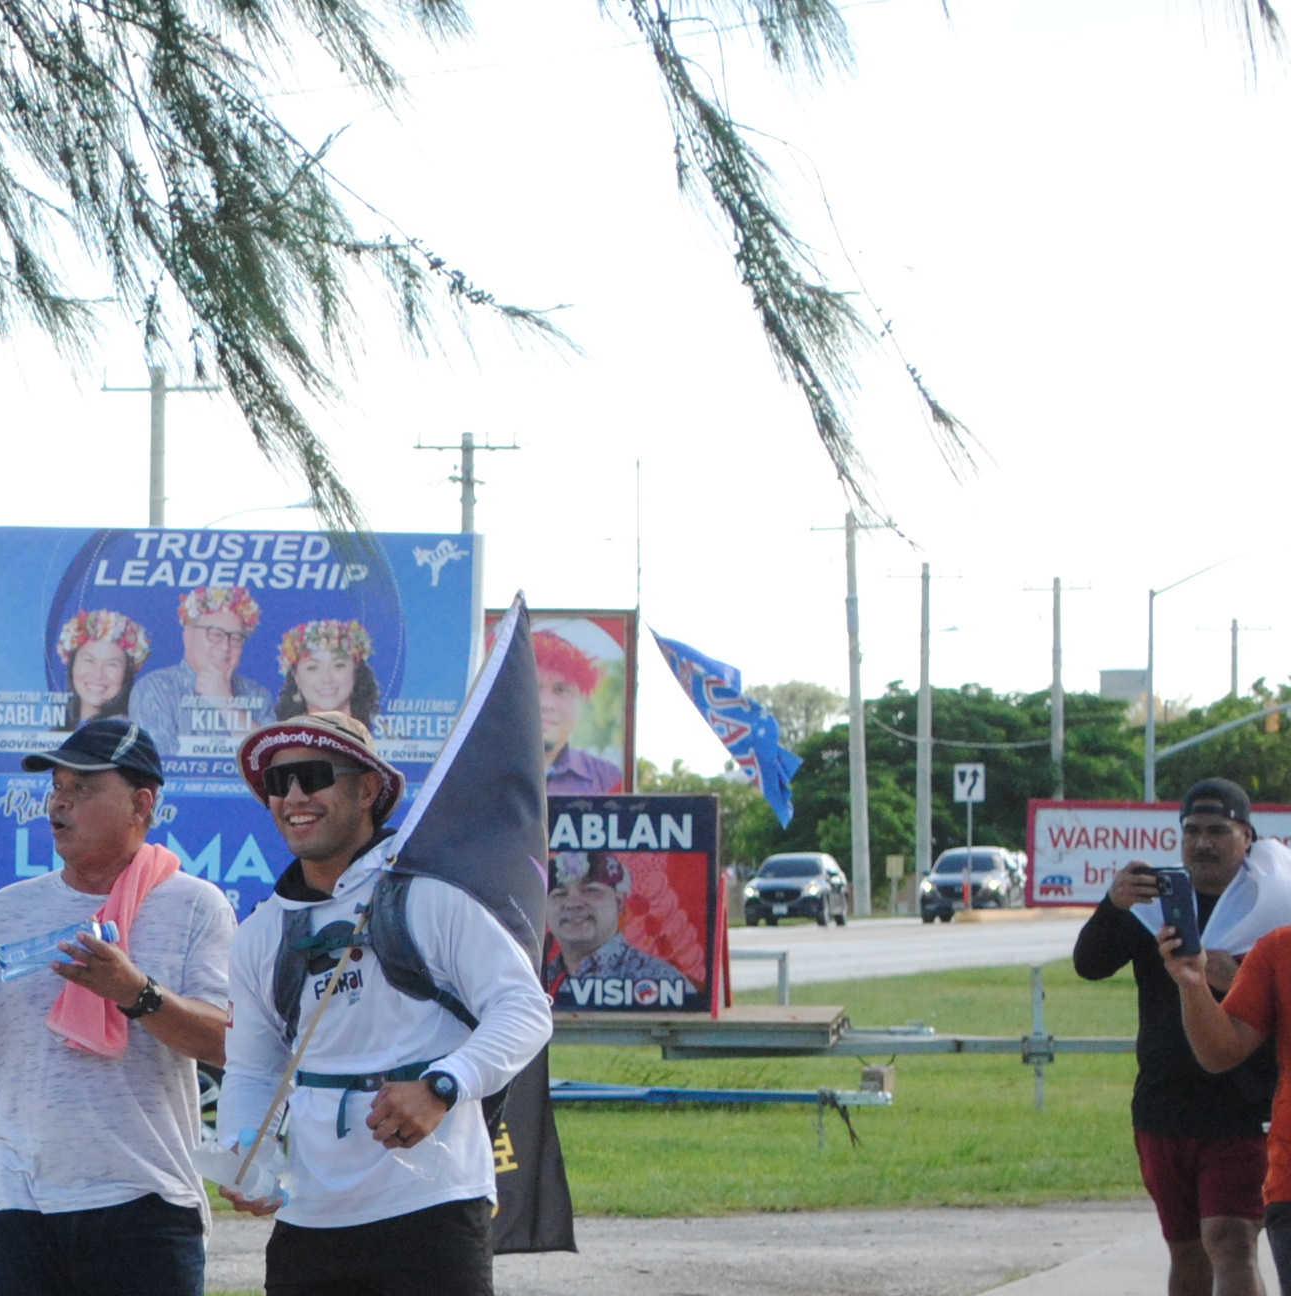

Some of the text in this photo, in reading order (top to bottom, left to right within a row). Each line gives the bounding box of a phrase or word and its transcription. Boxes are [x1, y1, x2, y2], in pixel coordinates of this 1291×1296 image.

[134, 532, 330, 561] TRUSTED
[93, 560, 369, 590] LEADERSHIP
[191, 710, 252, 731] KILILI
[193, 745, 239, 753] DELEGA
[391, 751, 440, 759] GOVERNO
[549, 813, 693, 849] ABLAN
[1048, 826, 1177, 851] WARNING
[569, 978, 684, 1006] VISION
